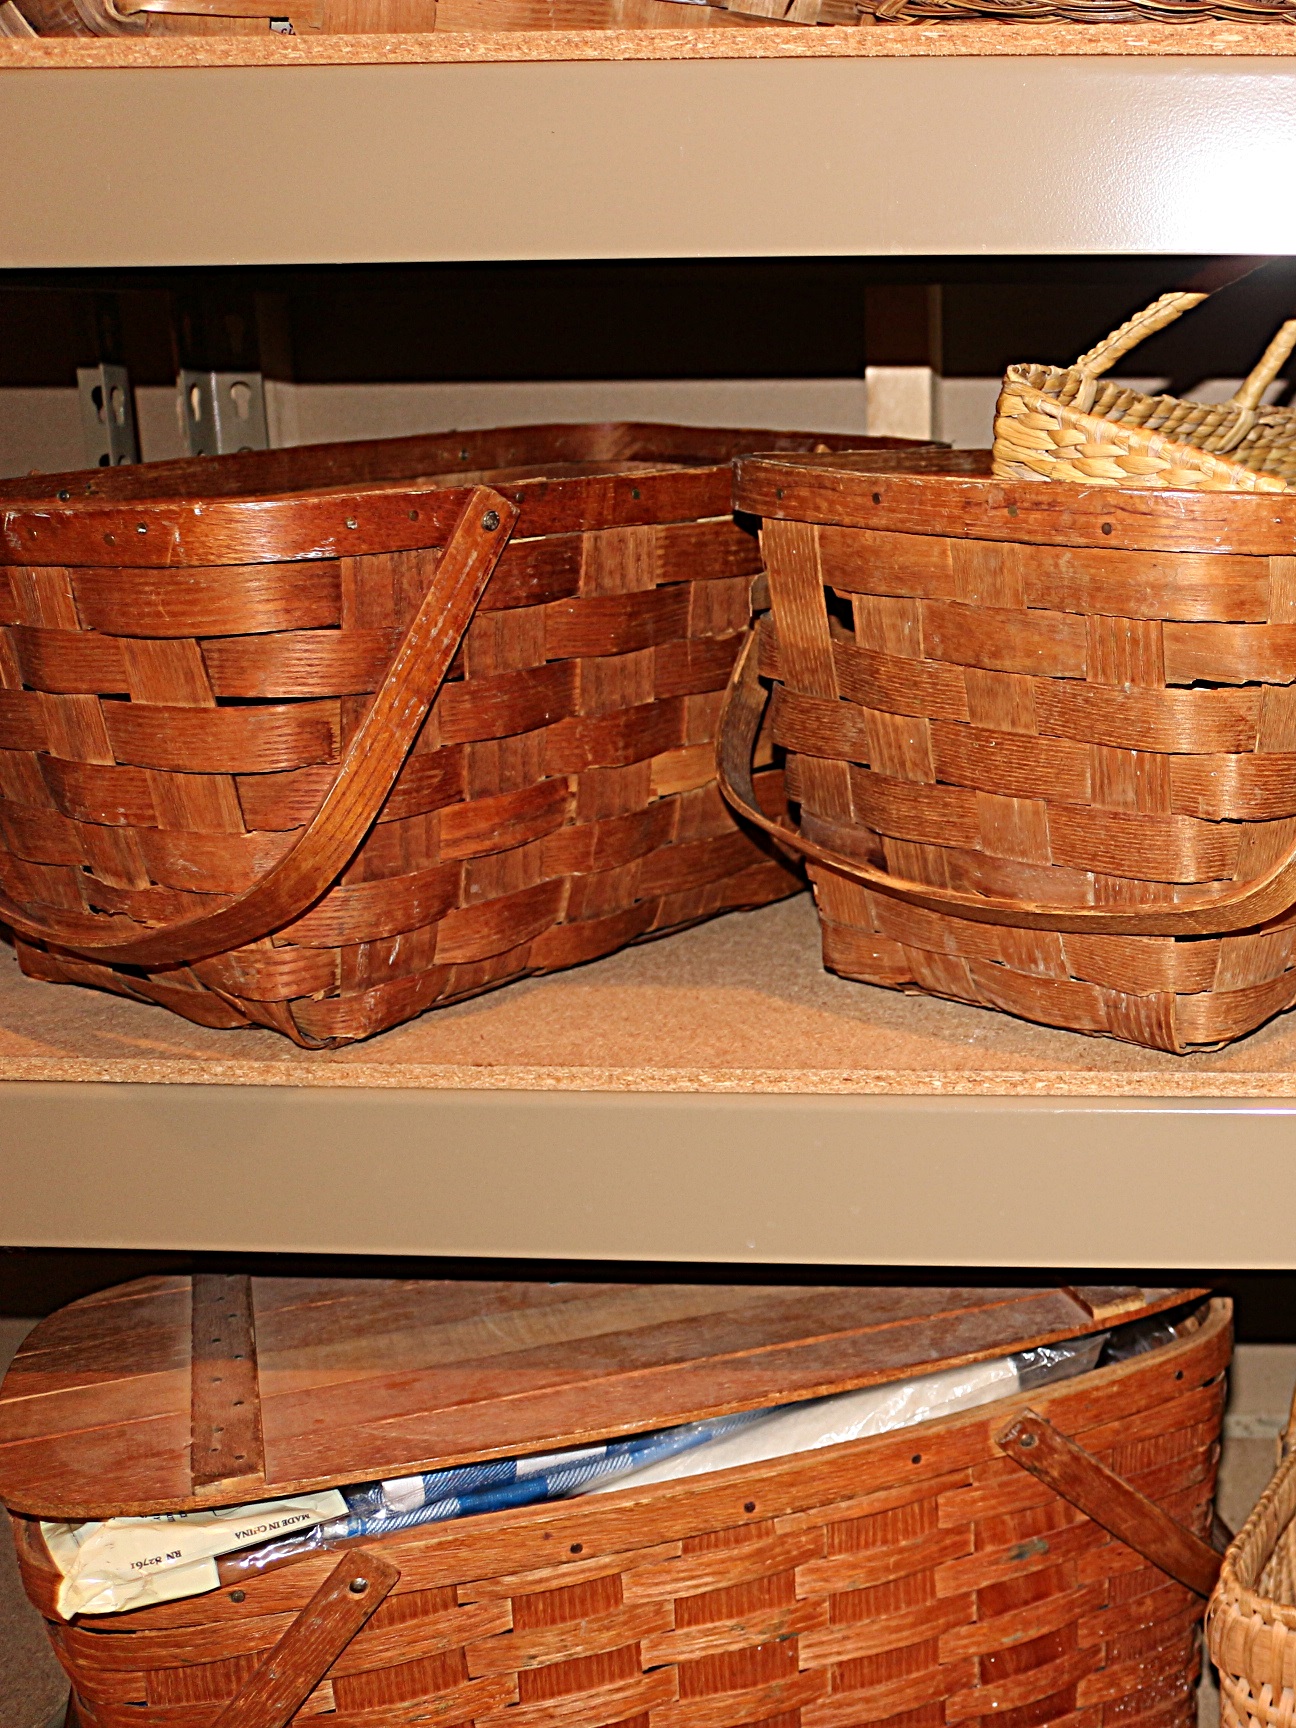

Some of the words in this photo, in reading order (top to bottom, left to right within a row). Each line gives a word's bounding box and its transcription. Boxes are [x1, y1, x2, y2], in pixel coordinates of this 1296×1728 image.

[268, 1521, 281, 1531] IN
[281, 1513, 311, 1527] MADE
[234, 1524, 268, 1540] CHINA
[165, 1549, 182, 1561] RN
[129, 1556, 163, 1570] 82761
